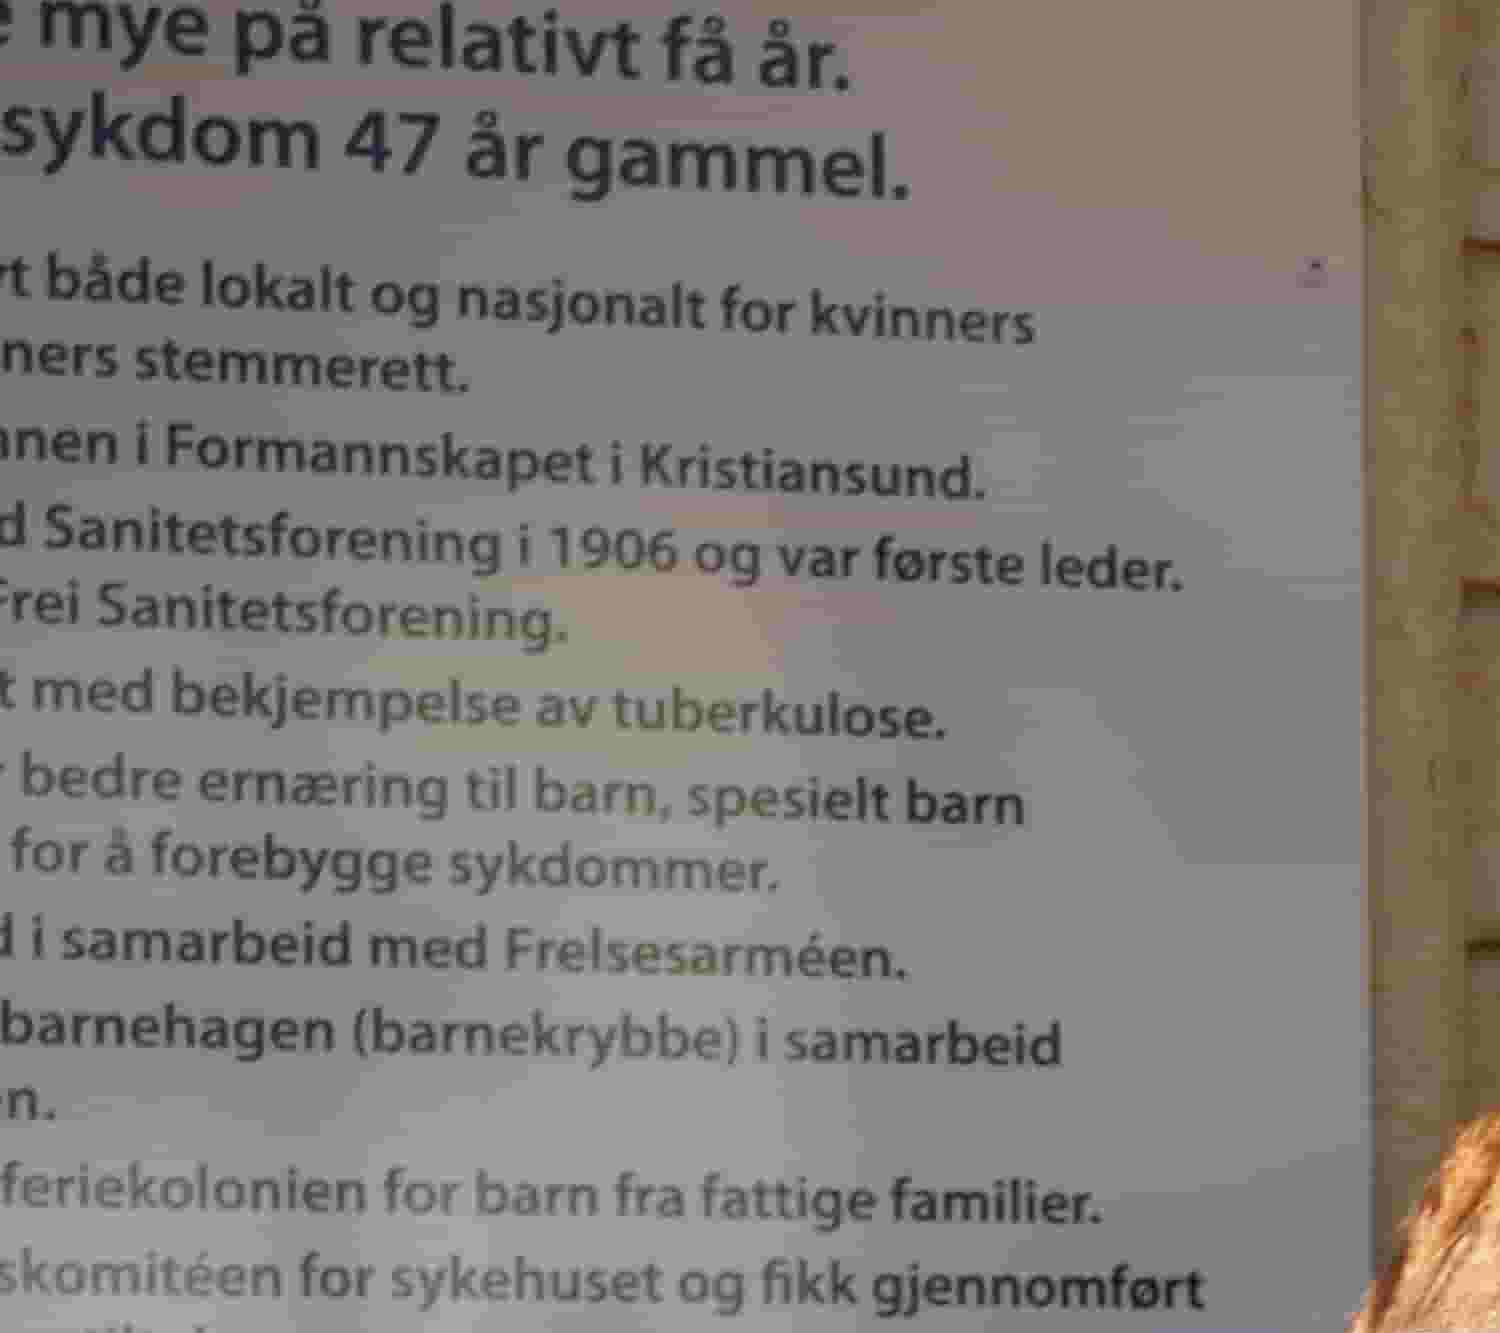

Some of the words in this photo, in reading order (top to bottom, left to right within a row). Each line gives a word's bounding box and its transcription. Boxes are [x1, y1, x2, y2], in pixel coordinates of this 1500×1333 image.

[40, 0, 208, 72] mye
[235, 0, 329, 76] på
[358, 0, 640, 80] relativt
[659, 14, 734, 85] få
[760, 19, 849, 92] år.
[0, 91, 320, 176] sykdom
[344, 110, 440, 176] 47
[466, 110, 544, 181] år
[566, 131, 909, 203] gammel.
[46, 250, 186, 306] både
[200, 259, 356, 312] lokalt
[371, 281, 440, 328] og
[458, 278, 706, 336] nasjonalt
[720, 283, 797, 334] for
[810, 288, 1035, 344] kvinners
[0, 339, 120, 378] ners
[136, 338, 469, 394] stemmerett.
[0, 427, 118, 464] nen
[136, 419, 148, 464] i
[168, 422, 595, 493] Formannskapet
[611, 440, 622, 484] i
[640, 443, 984, 501] Kristiansund.
[45, 504, 501, 576] Sanitetsforening
[520, 524, 530, 566] i
[551, 526, 679, 572] 1906
[694, 542, 760, 588] og
[776, 545, 860, 580] var
[872, 538, 1024, 587] første
[1040, 539, 1184, 592] leder.
[0, 576, 80, 624] rei
[97, 582, 568, 655] Sanitetsforening.
[32, 668, 152, 712] med
[172, 667, 520, 733] bekjempelse
[536, 694, 598, 728] av
[612, 686, 946, 740] tuberkulose.
[22, 750, 182, 800] bedre
[198, 760, 448, 821] ernæring
[466, 765, 516, 810] til
[536, 766, 672, 824] barn,
[688, 776, 890, 829] spesielt
[906, 776, 1024, 826] barn
[10, 825, 88, 872] for
[104, 827, 133, 875] å
[152, 829, 432, 895] forebygge
[451, 840, 776, 896] sykdommer.
[32, 912, 44, 960] i
[62, 918, 352, 968] samarbeid
[368, 922, 488, 969] med
[506, 928, 908, 981] Frelsesarméen.
[0, 998, 336, 1063] barnehagen
[353, 1006, 739, 1072] (barnekrybbe)
[758, 1016, 768, 1060] i
[784, 1019, 1064, 1069] samarbeid
[0, 1160, 366, 1213] feriekolonien
[384, 1168, 460, 1216] for
[476, 1168, 600, 1216] barn
[614, 1171, 685, 1218] fra
[700, 1171, 879, 1232] fattige
[888, 1176, 1103, 1224] familier.
[299, 1249, 376, 1299] for
[392, 1256, 664, 1312] sykehuset
[679, 1270, 744, 1316] og
[762, 1258, 858, 1304] fikk
[872, 1262, 1206, 1319] gjennomført
